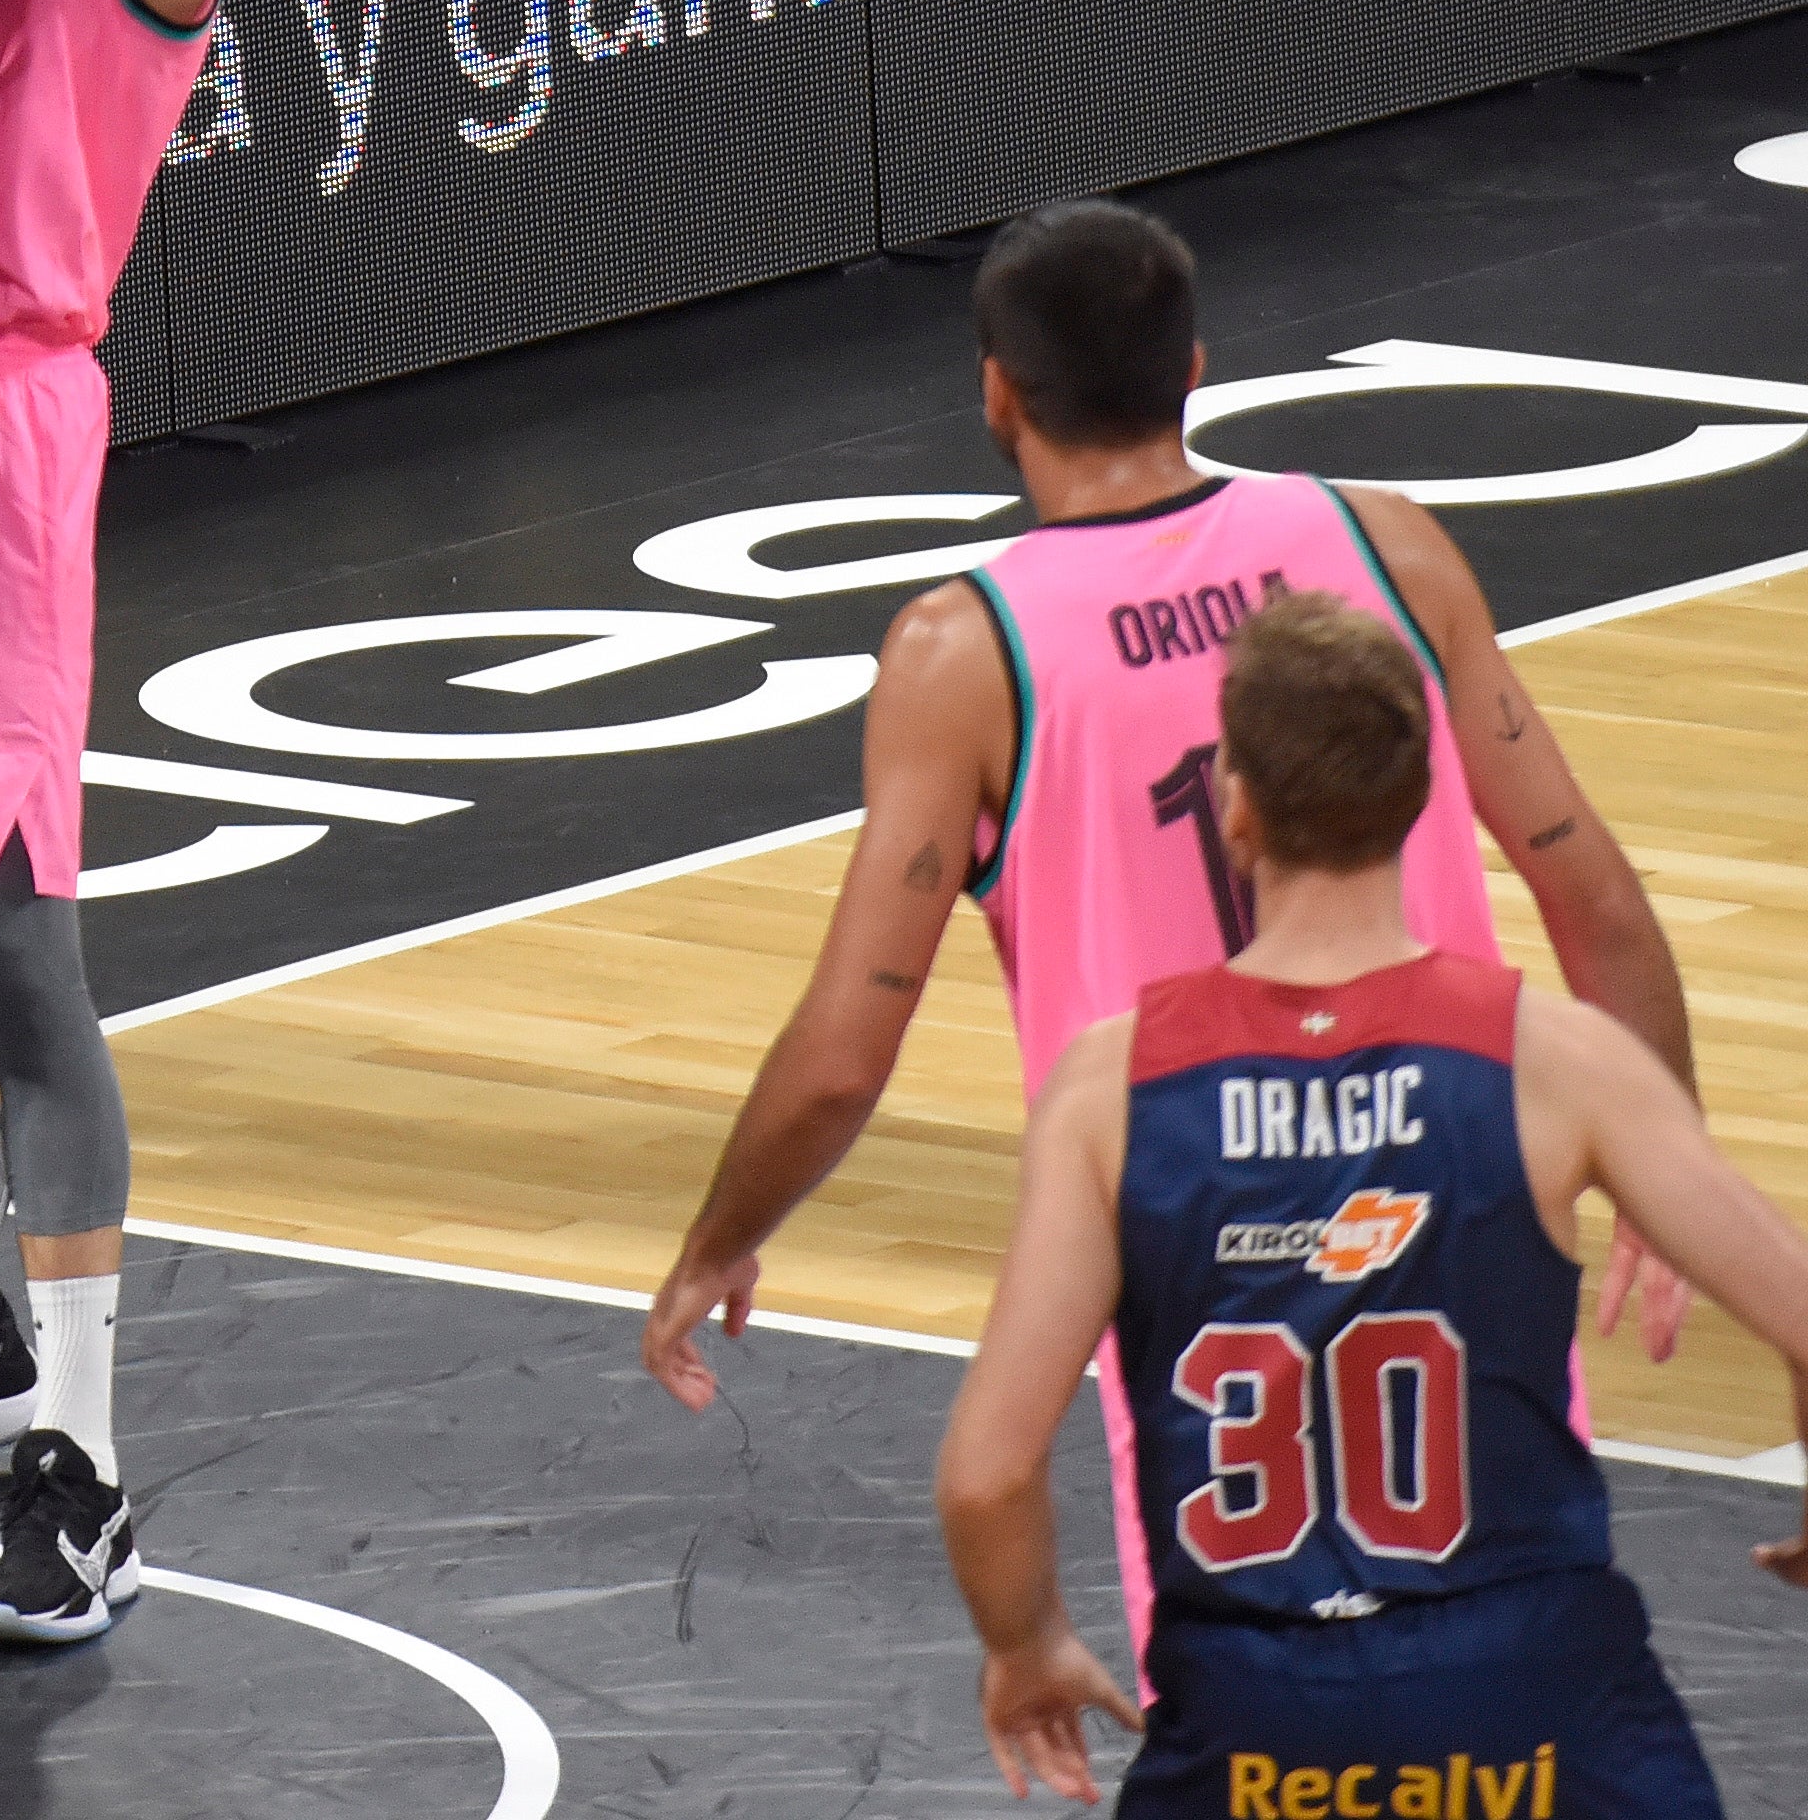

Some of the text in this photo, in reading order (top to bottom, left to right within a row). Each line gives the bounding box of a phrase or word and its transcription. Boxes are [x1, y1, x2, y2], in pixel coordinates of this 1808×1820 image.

[1107, 567, 1284, 669] ORIO
[1220, 1064, 1425, 1161] DRAGIC
[1172, 1310, 1470, 1573] 30
[1228, 1743, 1558, 1820] Recalvi
